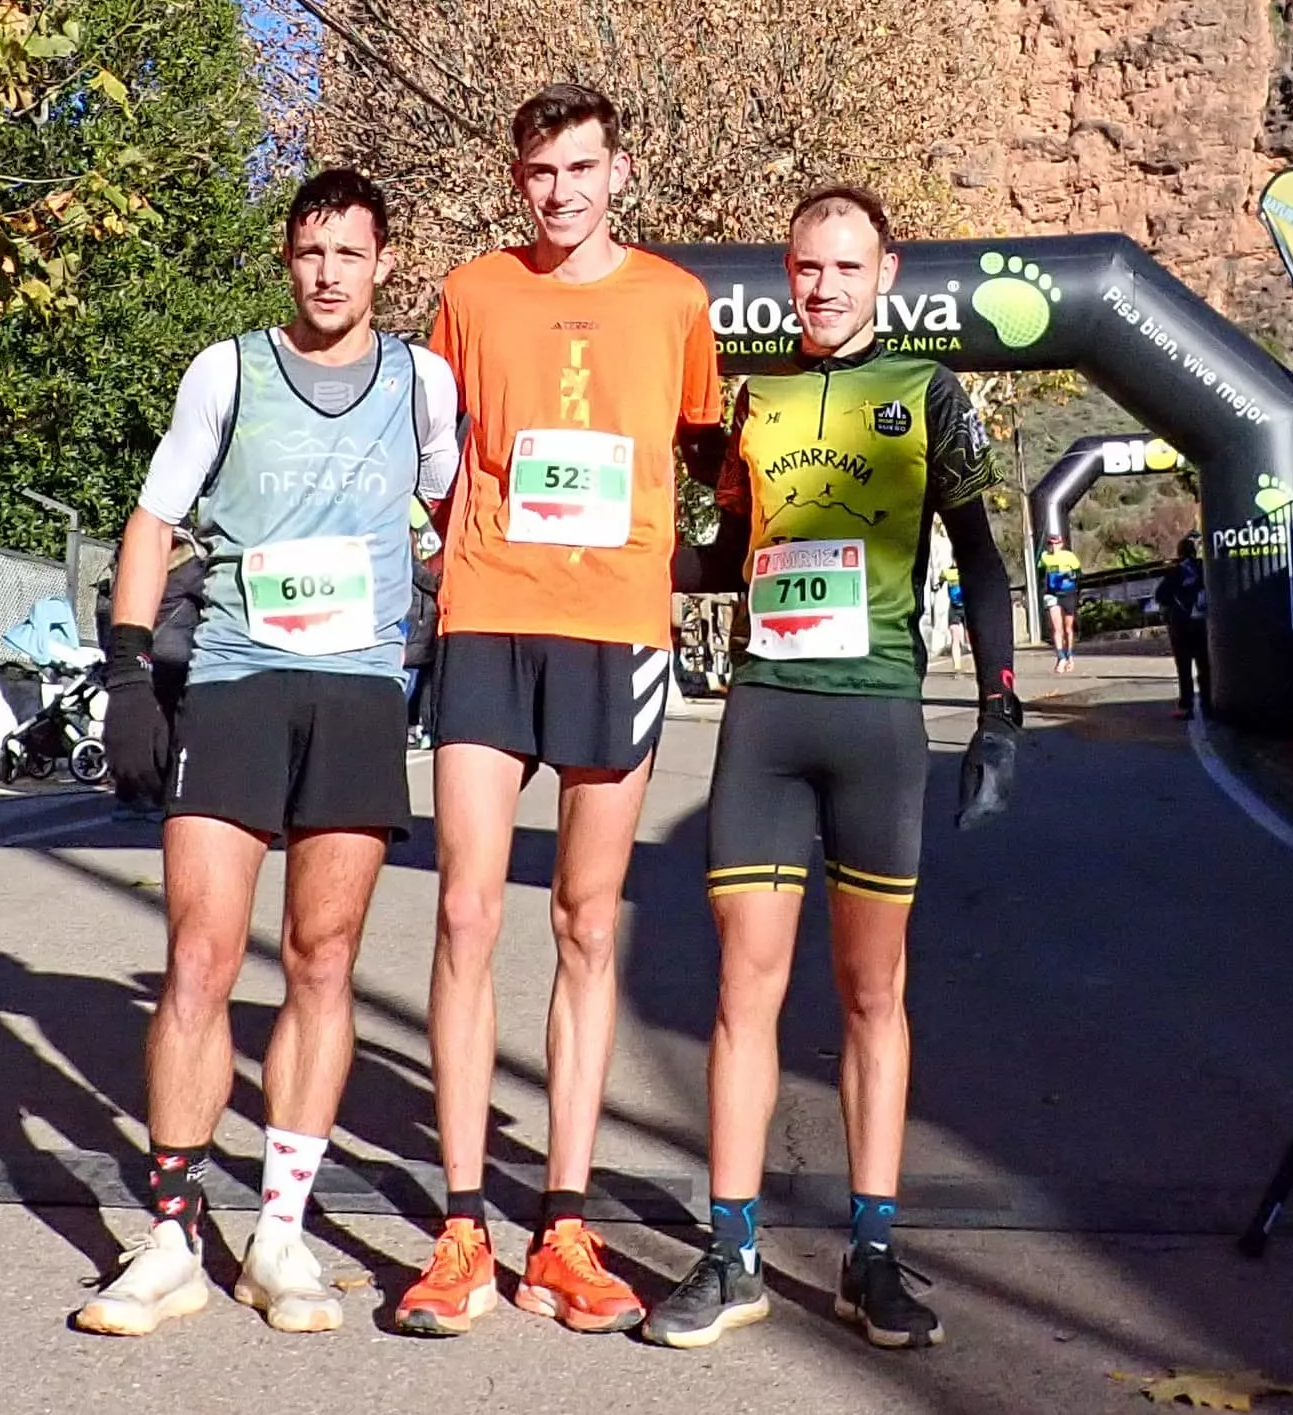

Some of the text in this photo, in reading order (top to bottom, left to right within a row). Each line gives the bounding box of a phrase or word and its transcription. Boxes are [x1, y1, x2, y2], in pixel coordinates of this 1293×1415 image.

[1102, 285, 1271, 425] Pisa bien, vive mejor
[764, 447, 874, 487] MATARRAÑA
[1102, 438, 1185, 474] BIO
[1212, 519, 1287, 560] podoa
[775, 576, 827, 604] 710
